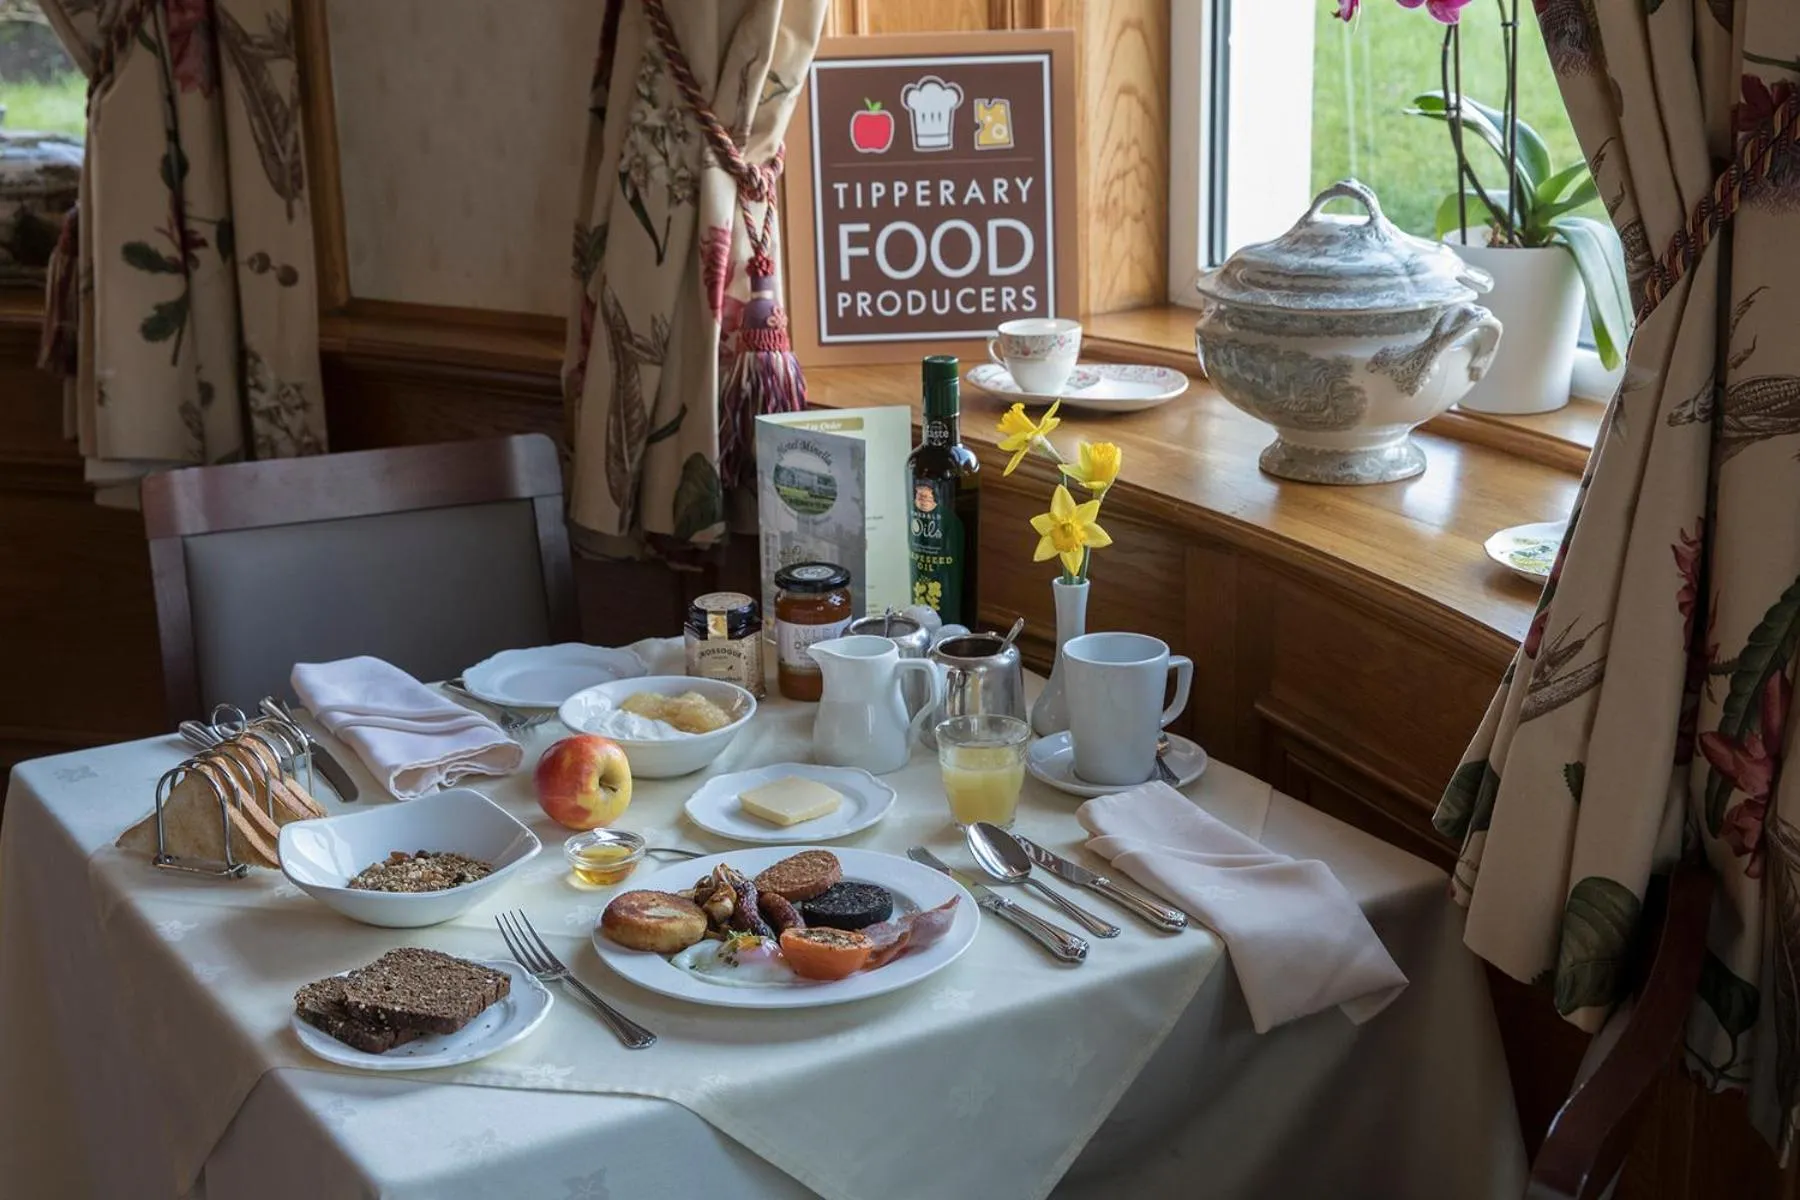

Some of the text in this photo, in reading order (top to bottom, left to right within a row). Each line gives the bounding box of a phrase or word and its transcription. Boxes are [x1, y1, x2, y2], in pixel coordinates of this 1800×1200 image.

[833, 177, 1033, 209] TIPPERARY
[839, 218, 1034, 281] FOOD
[838, 285, 1037, 318] PRODUCERS
[911, 518, 943, 539] Oils
[911, 551, 953, 565] APESEED
[917, 562, 934, 572] OIL
